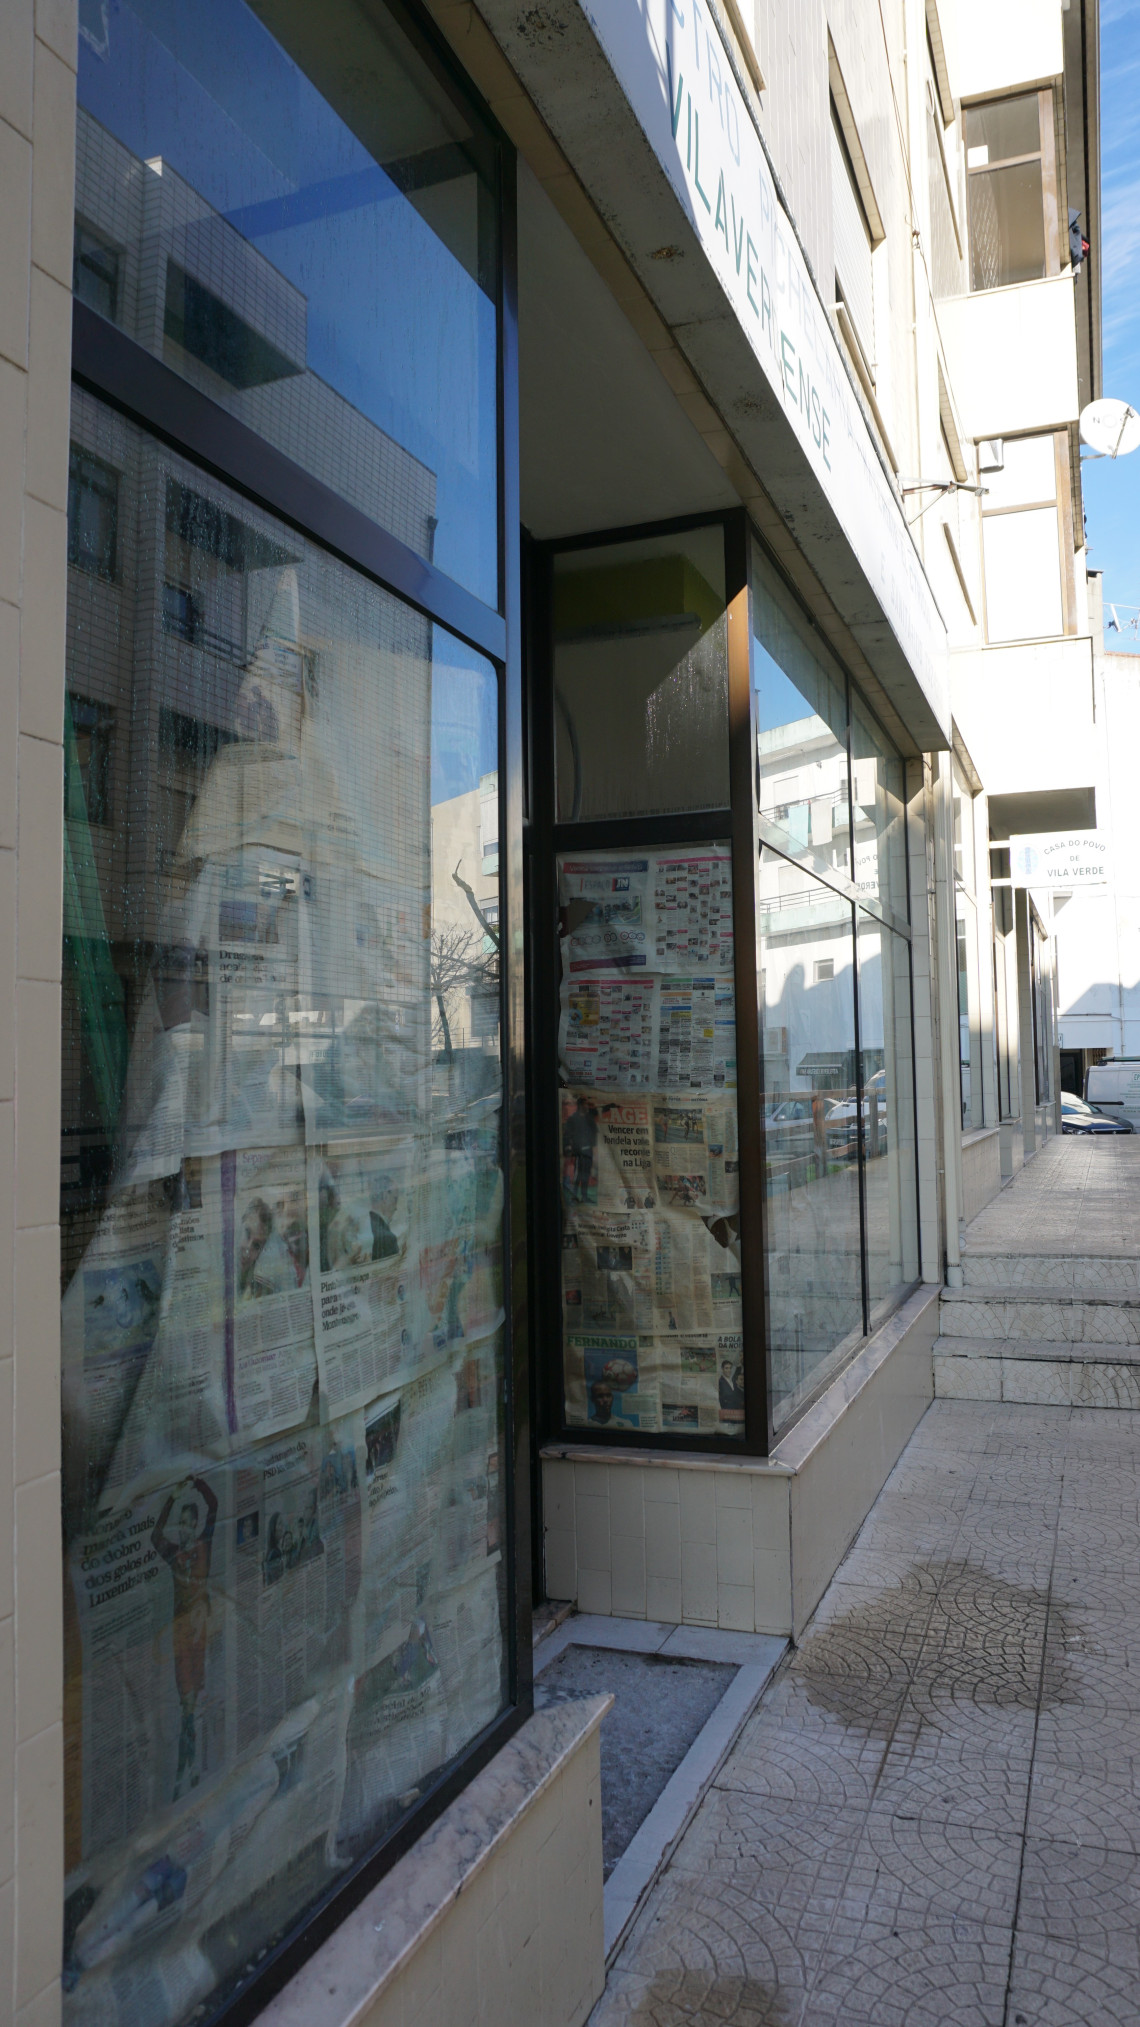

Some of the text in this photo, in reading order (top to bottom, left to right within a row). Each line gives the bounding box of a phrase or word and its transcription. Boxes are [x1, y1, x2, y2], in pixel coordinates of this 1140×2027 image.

[1044, 842, 1066, 855] CASA
[1083, 840, 1106, 852] POVO
[1048, 866, 1104, 877] VILA VERDE
[608, 1124, 649, 1135] Vencer em
[567, 1335, 637, 1349] FERNANDO
[127, 1514, 156, 1537] mais
[81, 1541, 142, 1572] do dobro
[84, 1549, 158, 1590] dos golos do
